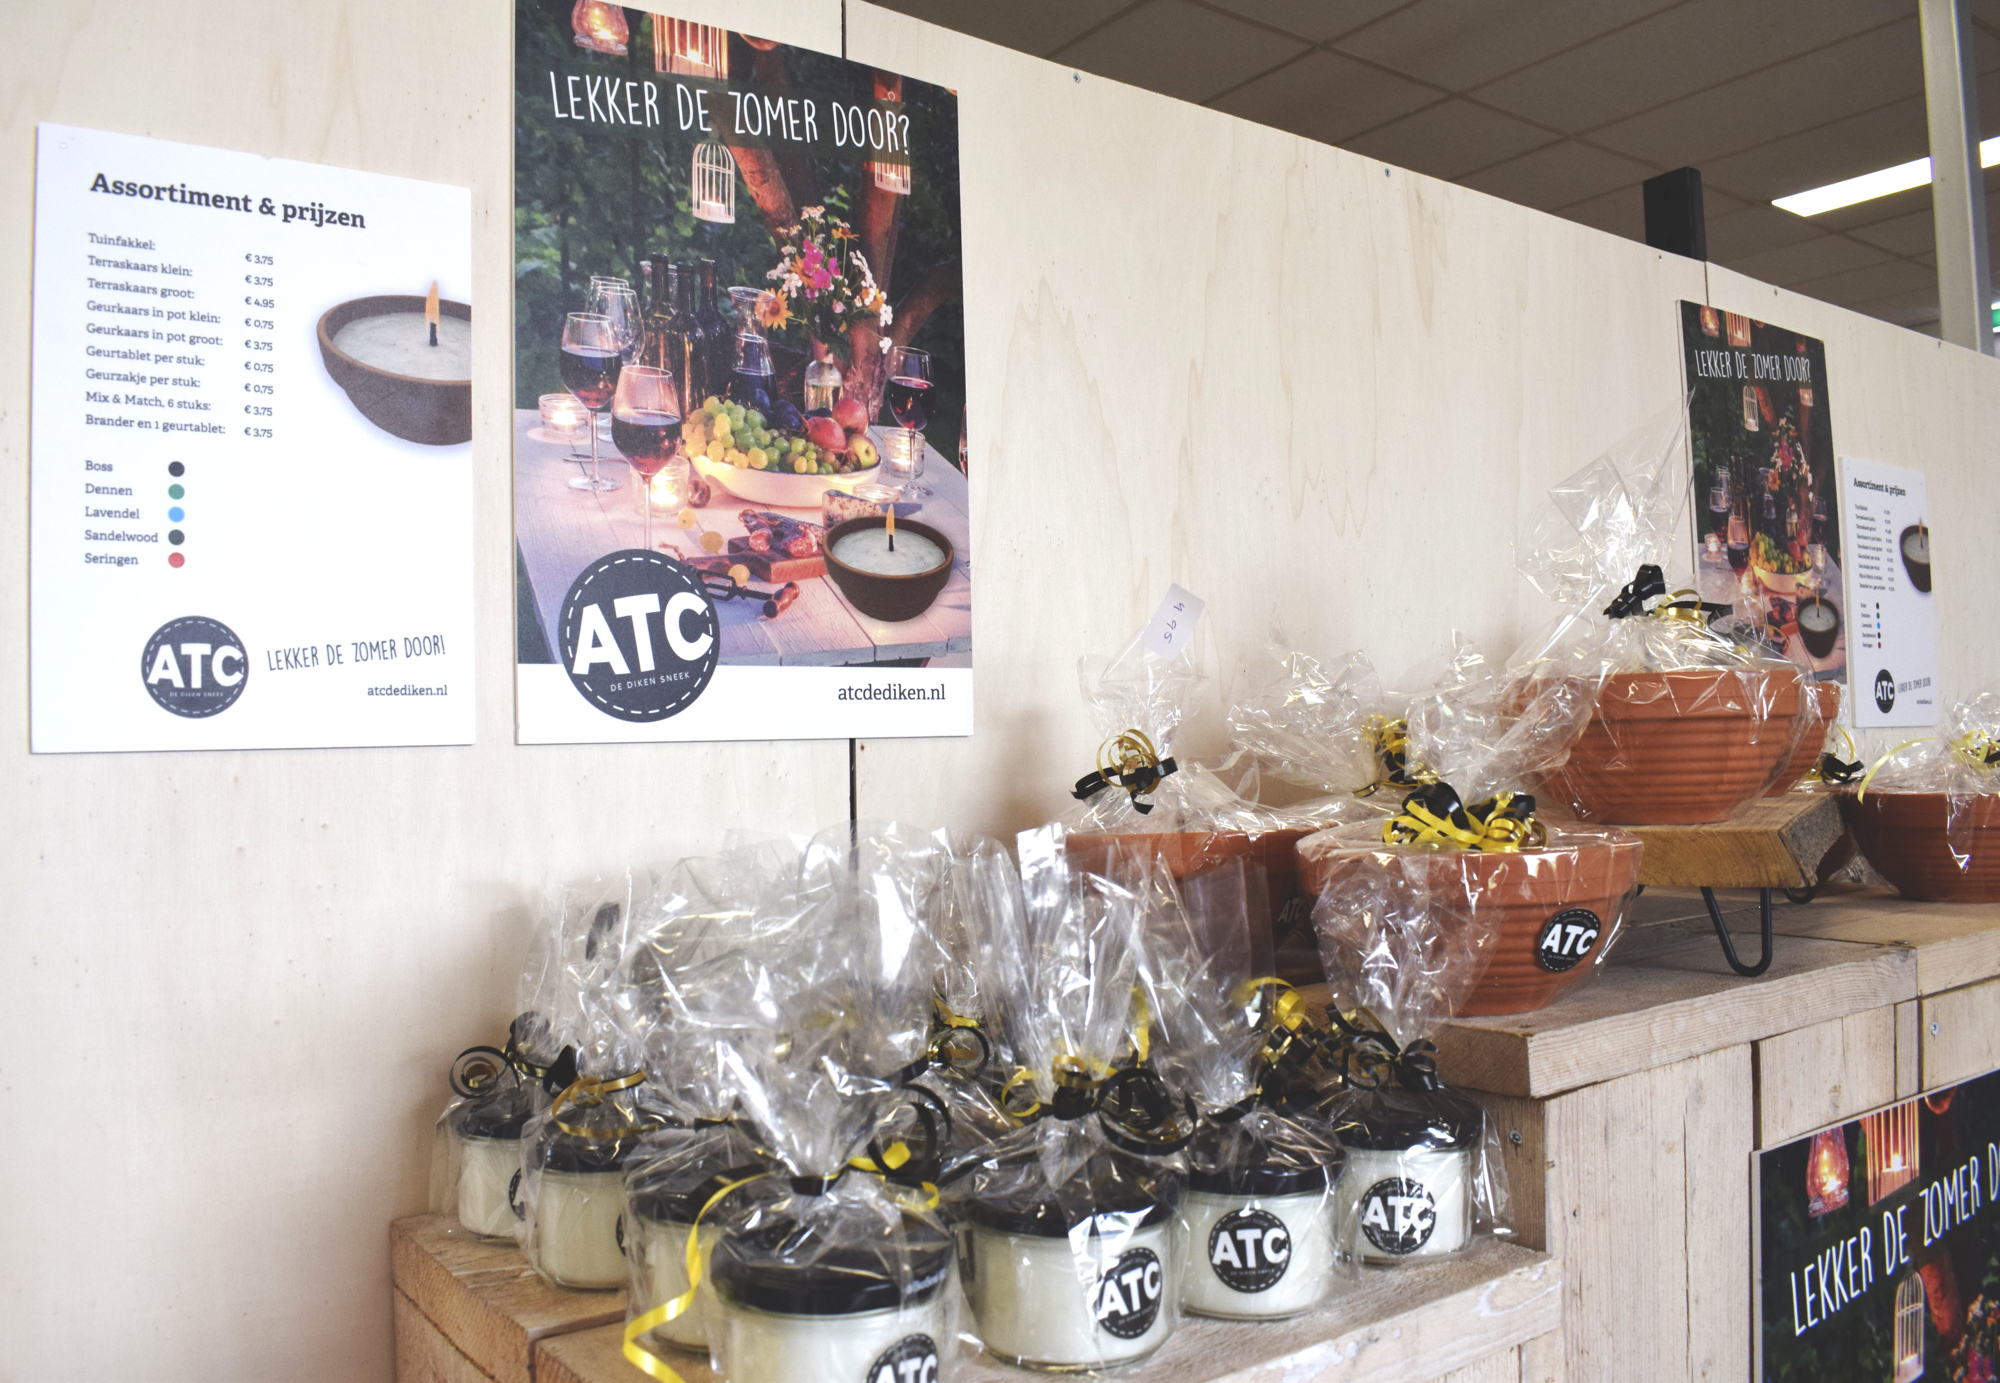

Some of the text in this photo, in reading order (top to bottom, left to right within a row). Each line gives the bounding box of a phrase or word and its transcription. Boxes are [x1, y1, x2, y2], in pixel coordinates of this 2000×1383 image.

[550, 71, 911, 156] LEKKER DE ZOMER DOOR?
[89, 172, 366, 228] Assortiment & prijzen
[87, 232, 156, 250] Tuinfakkel:
[245, 253, 252, 262] €
[87, 255, 158, 273] Terraskaars
[161, 263, 193, 277] klein:
[245, 274, 252, 284] €
[86, 277, 158, 295] Terraskaars
[160, 287, 195, 299] groot:
[245, 296, 252, 305] €
[86, 300, 149, 316] Geurkaars
[152, 306, 164, 318] in
[166, 310, 186, 321] pot
[189, 310, 221, 323] klein:
[245, 317, 252, 327] €
[86, 323, 149, 339] Geurkaars
[152, 329, 164, 340] in
[166, 332, 186, 343] pot
[189, 335, 223, 346] groot:
[245, 339, 252, 348] €
[86, 345, 152, 361] Geurtablet
[154, 353, 174, 364] per
[176, 355, 205, 366] stuk:
[244, 361, 252, 370] €
[1695, 349, 1811, 383] LEKKER DE ZOMER DOOR?
[85, 368, 147, 385] Geurzakje
[150, 375, 169, 386] per
[172, 377, 201, 388] stuk:
[244, 383, 252, 392] €
[85, 391, 109, 403] Mix
[112, 394, 121, 404] &
[124, 394, 165, 408] Match,
[167, 398, 174, 408] 6
[177, 400, 211, 411] stuks:
[244, 405, 252, 414] €
[85, 414, 135, 428] Brander
[137, 420, 152, 429] en
[155, 421, 160, 430] 1
[162, 422, 226, 434] geurtablet:
[244, 427, 252, 436] €
[85, 460, 113, 472] Boss
[85, 483, 133, 496] Dennen
[85, 506, 140, 519] Lavendel
[84, 529, 159, 543] Sandelwood
[84, 552, 139, 567] Seringen
[572, 591, 714, 676] ATC
[147, 642, 244, 689] ATC
[267, 634, 446, 672] LEKKER DE ZOMER DOOR!
[367, 684, 448, 696] atcdediken.nl
[610, 671, 690, 692] DE DIKEN SNEEK
[837, 683, 946, 702] atcdediken.nl
[1876, 680, 1895, 701] ATC
[1541, 923, 1598, 956] ATC
[1361, 1195, 1433, 1232] ATC
[1211, 1227, 1289, 1269] ATC
[1790, 1226, 1873, 1337] LEKKER
[1883, 1204, 1910, 1277] DE
[1918, 1155, 1981, 1248] ZOMER
[1096, 1261, 1161, 1320] ATC
